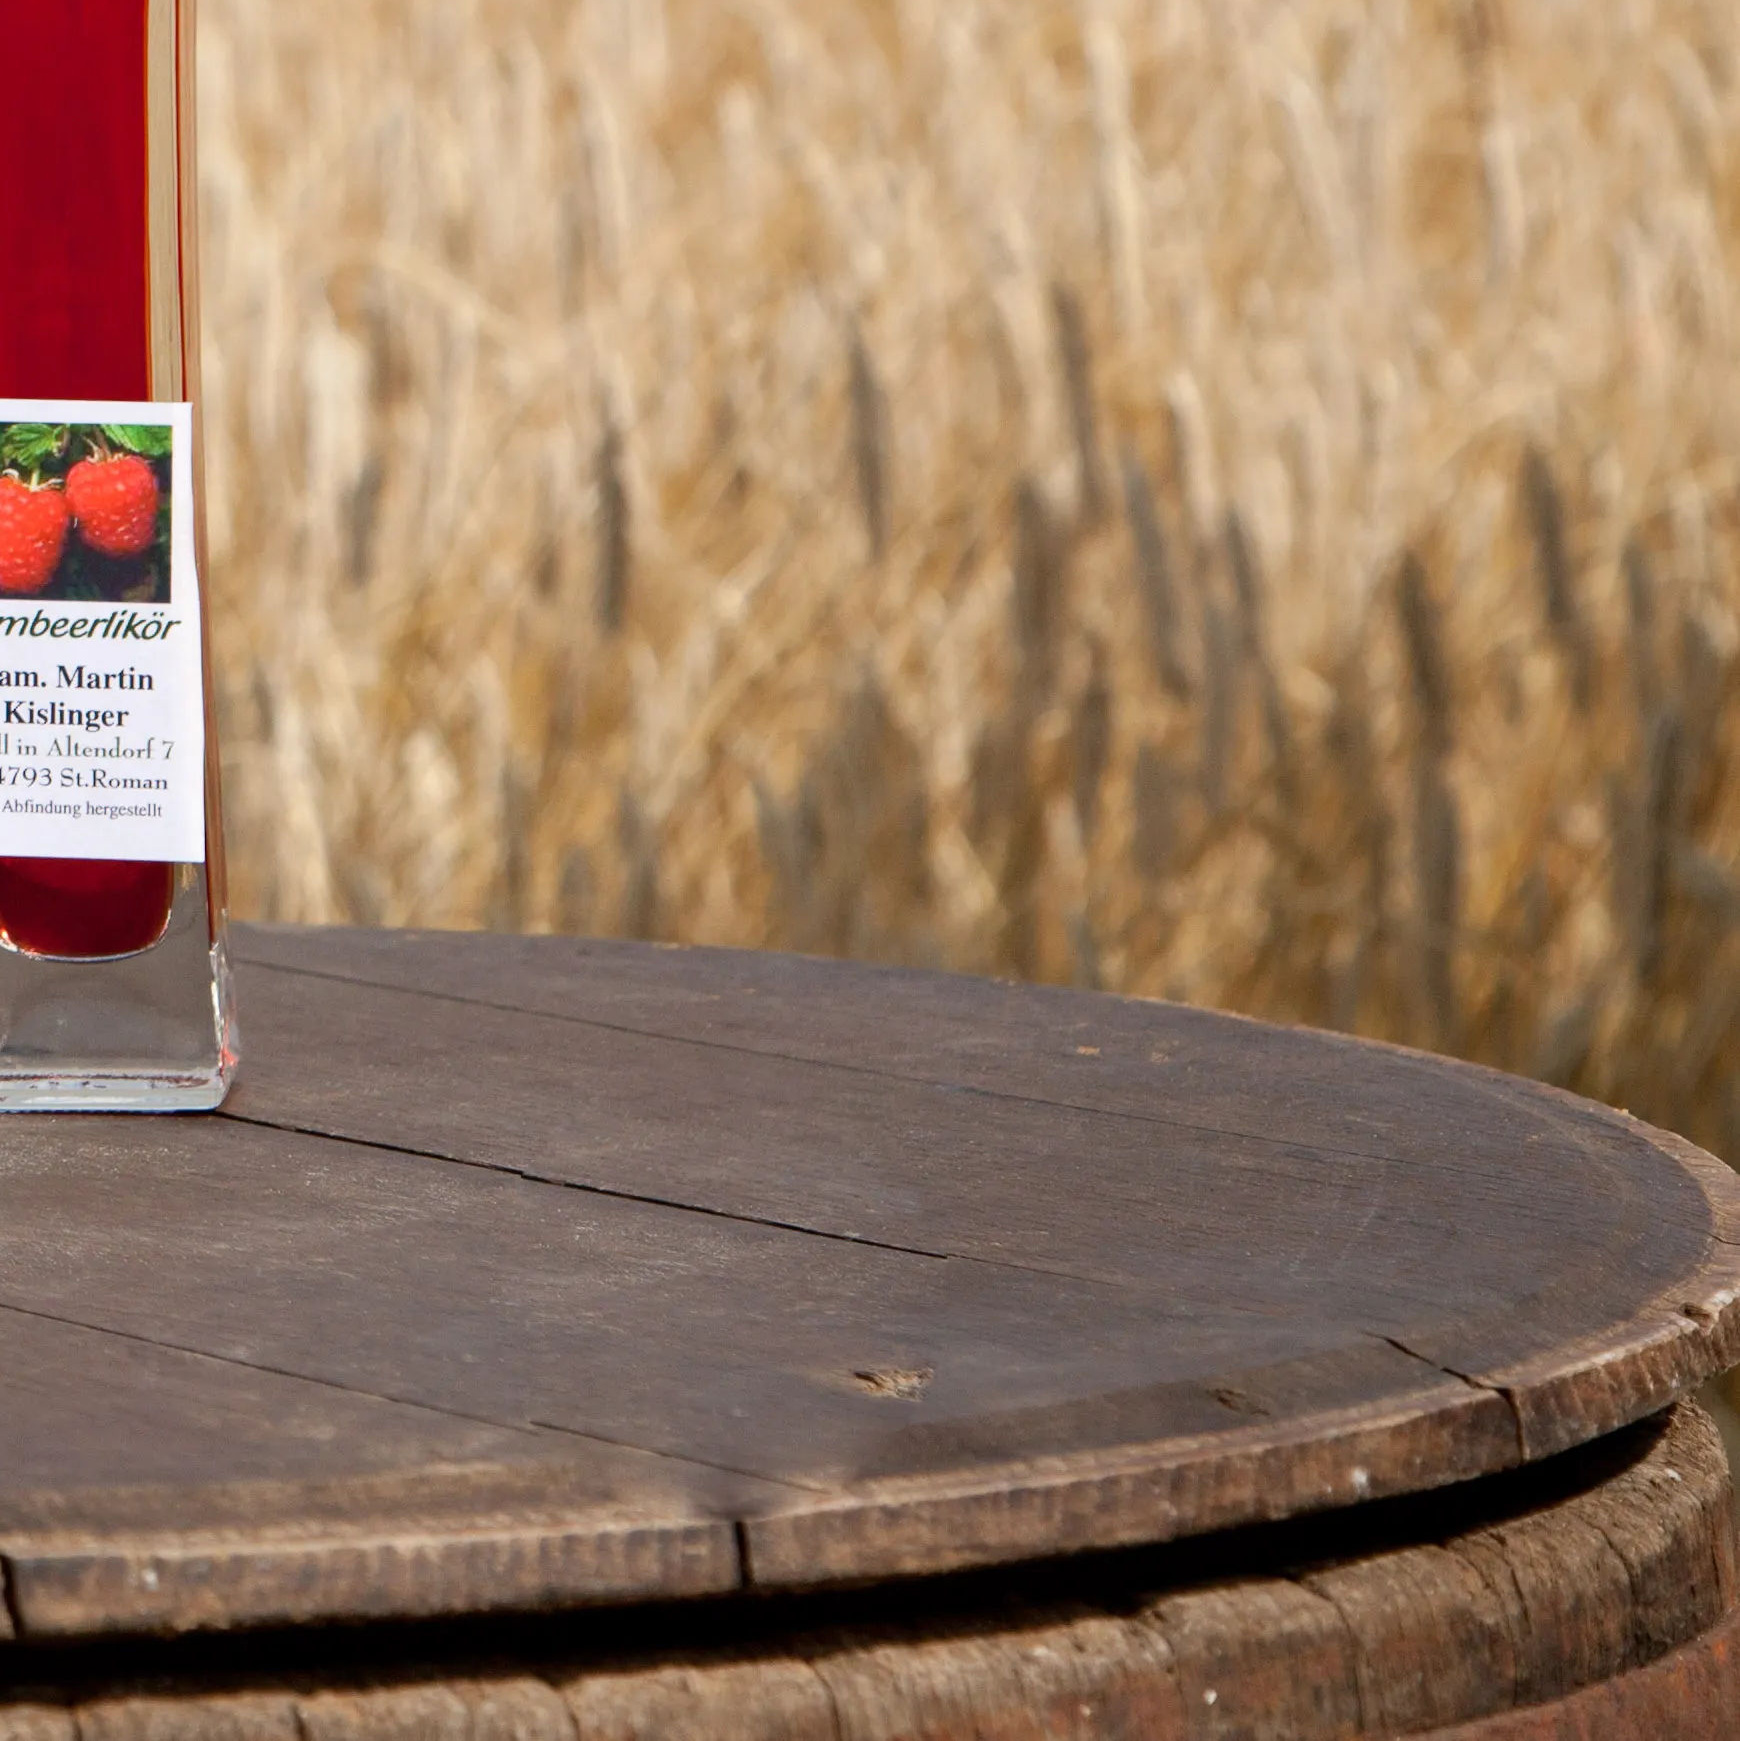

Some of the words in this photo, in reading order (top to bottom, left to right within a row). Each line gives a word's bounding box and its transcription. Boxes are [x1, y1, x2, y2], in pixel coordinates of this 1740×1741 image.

[56, 664, 154, 690] Martin
[4, 701, 129, 731] Kislinger
[17, 739, 38, 756] in
[46, 737, 157, 758] Altendorf
[162, 741, 174, 759] 7
[60, 768, 168, 790] St.Roman
[2, 800, 82, 817] Abfindung
[86, 801, 162, 819] hergestellt
